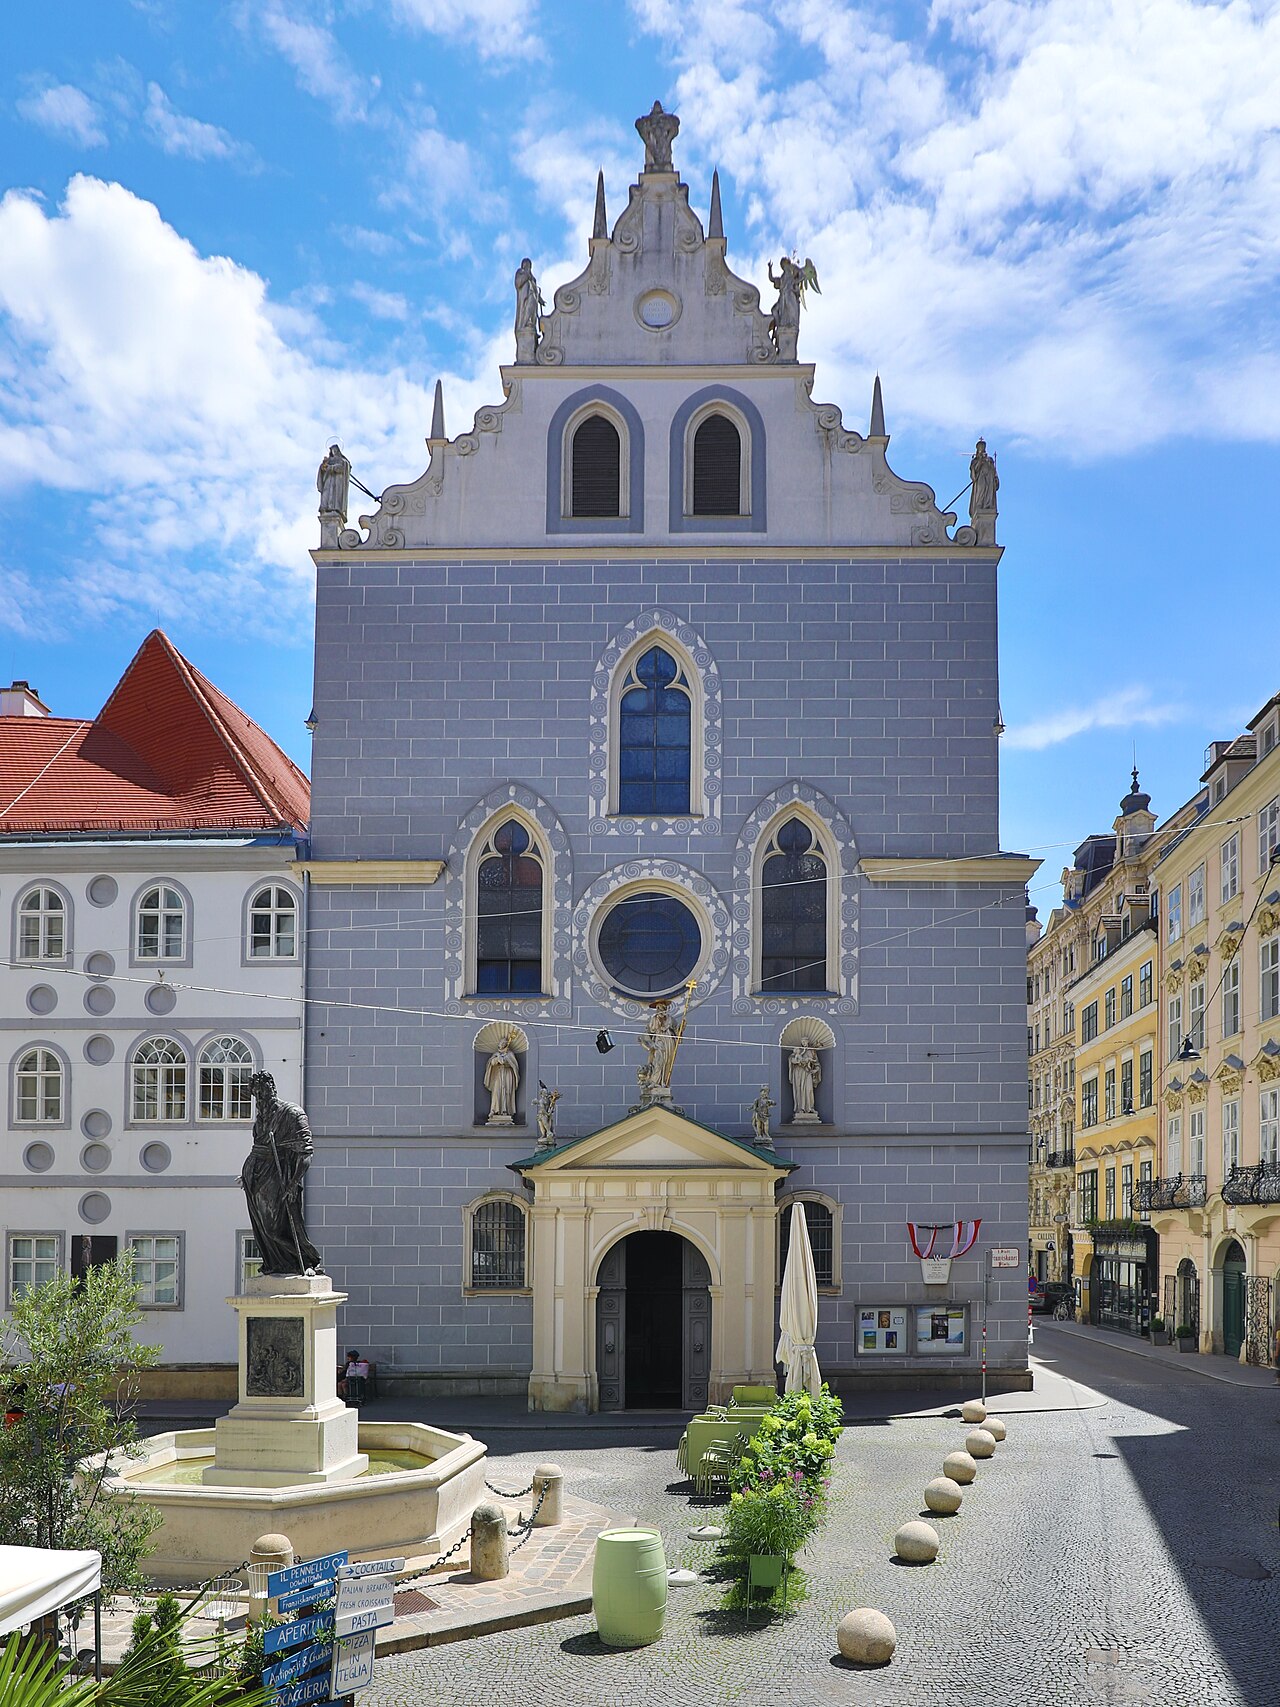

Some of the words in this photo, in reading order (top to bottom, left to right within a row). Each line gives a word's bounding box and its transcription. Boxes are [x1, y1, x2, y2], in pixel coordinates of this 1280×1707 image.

[280, 1572, 289, 1583] IL
[291, 1560, 330, 1579] PENNELLO
[354, 1560, 395, 1575] COCKTAILS
[289, 1573, 322, 1588] DOWNTOWN
[341, 1585, 363, 1595] ITALIAN
[366, 1582, 394, 1593] BREAKFAST
[339, 1601, 356, 1611] FRESH
[357, 1597, 391, 1609] CROISSANTS
[351, 1612, 378, 1630] PASTA
[344, 1634, 369, 1651] PIZZA
[302, 1655, 308, 1668] &
[349, 1653, 360, 1664] IN
[338, 1663, 368, 1682] TEGLIA
